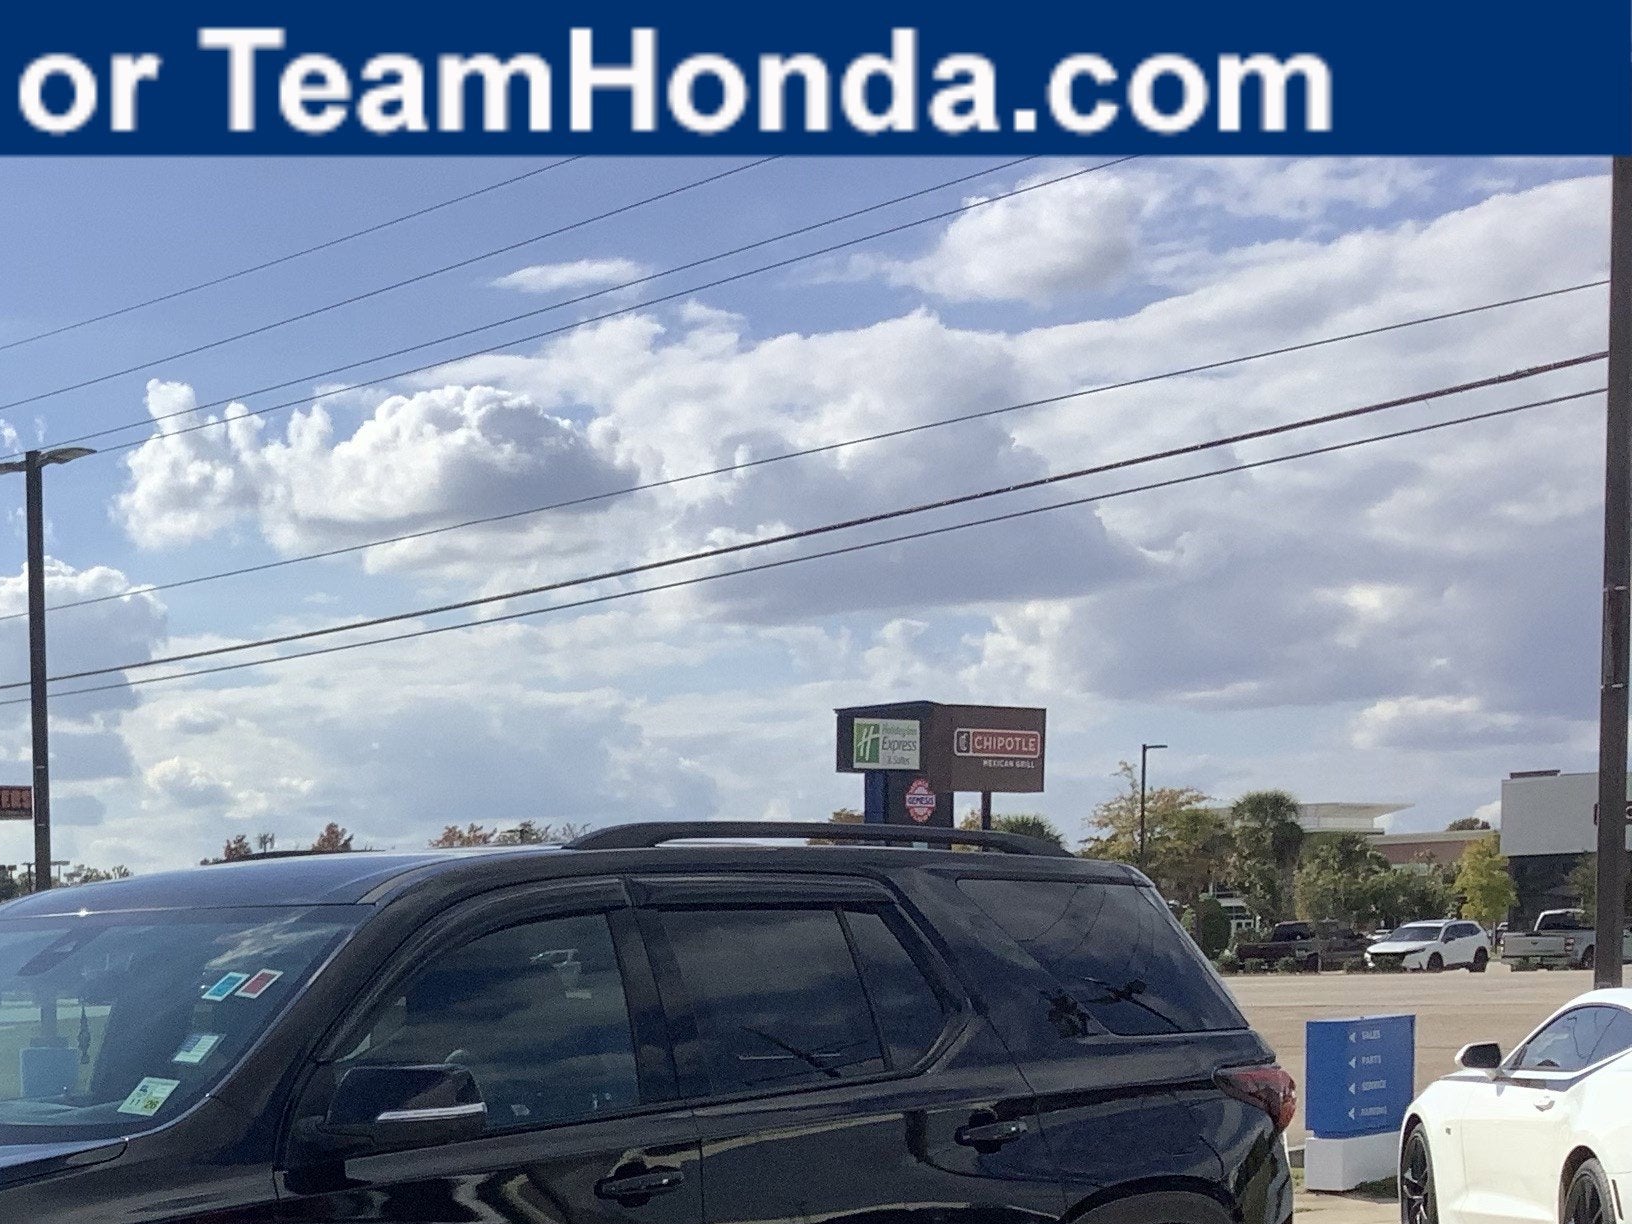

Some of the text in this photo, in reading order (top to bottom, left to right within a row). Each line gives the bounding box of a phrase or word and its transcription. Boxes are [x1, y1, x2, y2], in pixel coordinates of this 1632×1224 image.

[881, 736, 917, 754] Express
[974, 735, 1036, 752] CHIPOTLE
[983, 759, 1014, 768] MEXICAN
